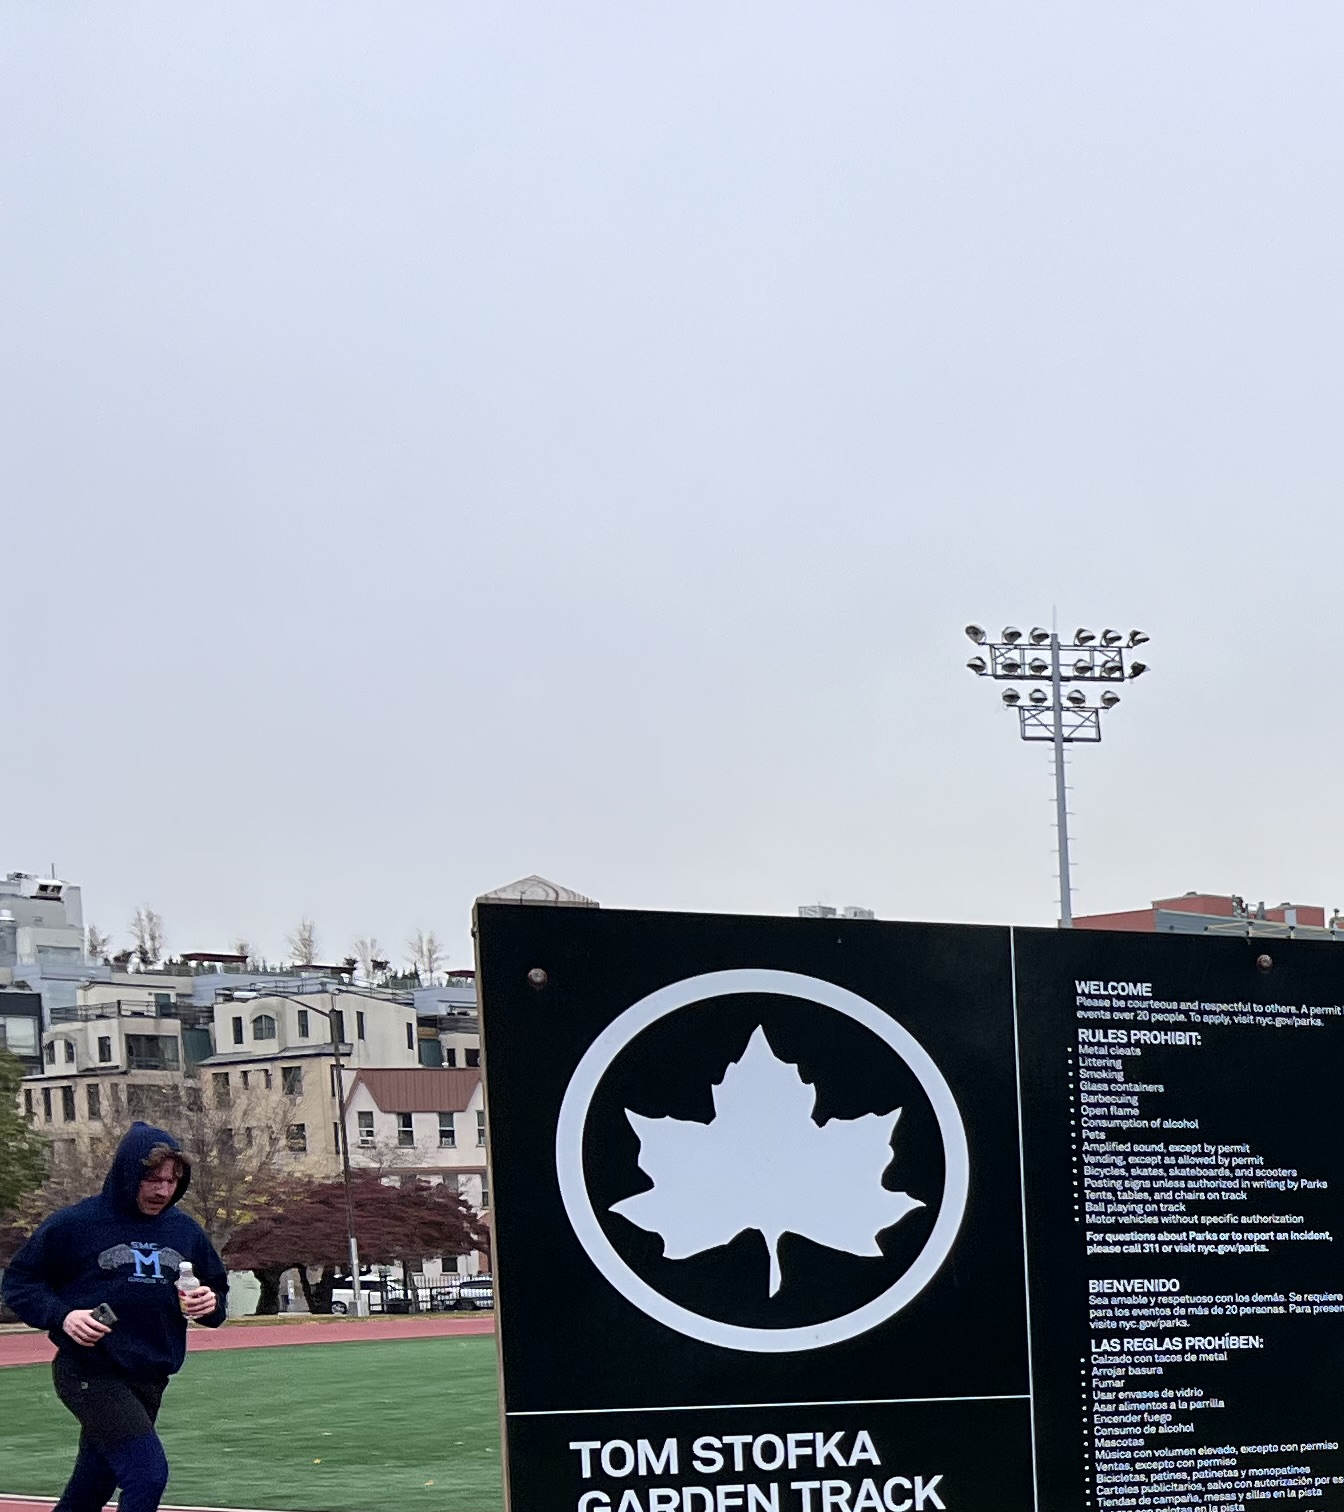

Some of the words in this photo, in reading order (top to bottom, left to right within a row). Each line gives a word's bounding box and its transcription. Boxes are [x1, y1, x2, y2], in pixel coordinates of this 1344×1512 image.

[1075, 980, 1153, 997] WELCOME
[1076, 996, 1111, 1008] Please
[1112, 997, 1126, 1008] be
[1126, 999, 1178, 1010] courteous
[1178, 1000, 1199, 1011] and
[1200, 1001, 1252, 1014] respectful
[1252, 1003, 1264, 1013] to
[1300, 1004, 1309, 1014] A
[1309, 1005, 1342, 1017] permit
[1076, 1009, 1112, 1020] events
[1112, 1011, 1135, 1020] over
[1136, 1010, 1150, 1021] 20
[1189, 1012, 1202, 1023] To
[1232, 1013, 1255, 1024] visit
[1078, 1029, 1128, 1044] RULES
[1130, 1029, 1202, 1046] PROHIBIT:
[1078, 1044, 1109, 1055] Metal
[1108, 1044, 1142, 1056] cleats
[1078, 1056, 1123, 1070] Littering
[1078, 1068, 1125, 1082] Smoking
[1079, 1080, 1110, 1092] Glass
[1109, 1081, 1165, 1093] containers
[1080, 1092, 1139, 1107] Barbecuing
[1080, 1105, 1109, 1118] Open
[1109, 1105, 1140, 1116] flame
[1081, 1117, 1149, 1130] Consumption
[1150, 1117, 1162, 1129] of
[1162, 1118, 1200, 1129] alcohol
[1081, 1128, 1106, 1140] Pets
[1081, 1141, 1132, 1154] Amplified
[1168, 1143, 1203, 1155] except
[1203, 1142, 1217, 1155] by
[1217, 1143, 1251, 1155] permit
[1127, 1155, 1162, 1167] except
[1163, 1156, 1177, 1165] as
[1177, 1154, 1217, 1165] allowed
[1217, 1154, 1231, 1168] by
[1231, 1155, 1265, 1167] permit
[1234, 1166, 1254, 1177] and
[1255, 1167, 1298, 1177] scooters
[1084, 1177, 1124, 1191] Posting
[1124, 1179, 1152, 1191] signs
[1152, 1178, 1186, 1189] unless
[1186, 1178, 1240, 1189] authorized
[1240, 1178, 1251, 1189] in
[1250, 1178, 1286, 1192] writing
[1286, 1178, 1299, 1192] by
[1300, 1178, 1328, 1189] Parks
[1153, 1190, 1174, 1200] and
[1174, 1189, 1206, 1201] chairs
[1206, 1192, 1220, 1201] on
[1220, 1190, 1248, 1201] track
[1085, 1201, 1106, 1212] Ball
[1106, 1201, 1144, 1215] playing
[1144, 1203, 1158, 1212] on
[1159, 1201, 1187, 1212] track
[1085, 1213, 1117, 1224] Motor
[1116, 1213, 1160, 1224] vehicles
[1160, 1213, 1199, 1224] without
[1200, 1213, 1239, 1226] specific
[1240, 1213, 1305, 1224] authorization
[1085, 1231, 1105, 1242] For
[1104, 1230, 1157, 1244] questions
[1156, 1230, 1188, 1241] about
[1188, 1230, 1219, 1241] Parks
[1218, 1232, 1230, 1241] or
[1230, 1231, 1243, 1241] to
[1243, 1231, 1275, 1243] report
[1275, 1232, 1289, 1241] an
[1086, 1243, 1122, 1256] please
[1122, 1242, 1142, 1254] call
[1142, 1242, 1160, 1253] 311
[1161, 1244, 1173, 1253] or
[1173, 1242, 1197, 1253] visit
[129, 1249, 164, 1278] M
[1088, 1278, 1180, 1293] BIENVENIDO
[1090, 1338, 1121, 1353] LAS
[1123, 1336, 1183, 1352] REGLAS
[1184, 1335, 1264, 1351] PROHÍBEN:
[1091, 1365, 1127, 1378] Arrojar
[1127, 1365, 1164, 1376] basura
[1092, 1377, 1126, 1389] Fumar
[1092, 1390, 1117, 1401] Usar
[1117, 1390, 1160, 1400] envases
[1160, 1387, 1175, 1399] de
[1175, 1387, 1204, 1398] vidrio
[1093, 1412, 1142, 1425] Encender
[1143, 1411, 1173, 1425] fuego
[1093, 1425, 1142, 1436] Consumo
[1142, 1424, 1157, 1435] de
[1157, 1422, 1195, 1434] alcohol
[1094, 1437, 1145, 1448] Mascotas
[568, 1437, 679, 1479] TOM
[692, 1430, 882, 1474] STOFKA
